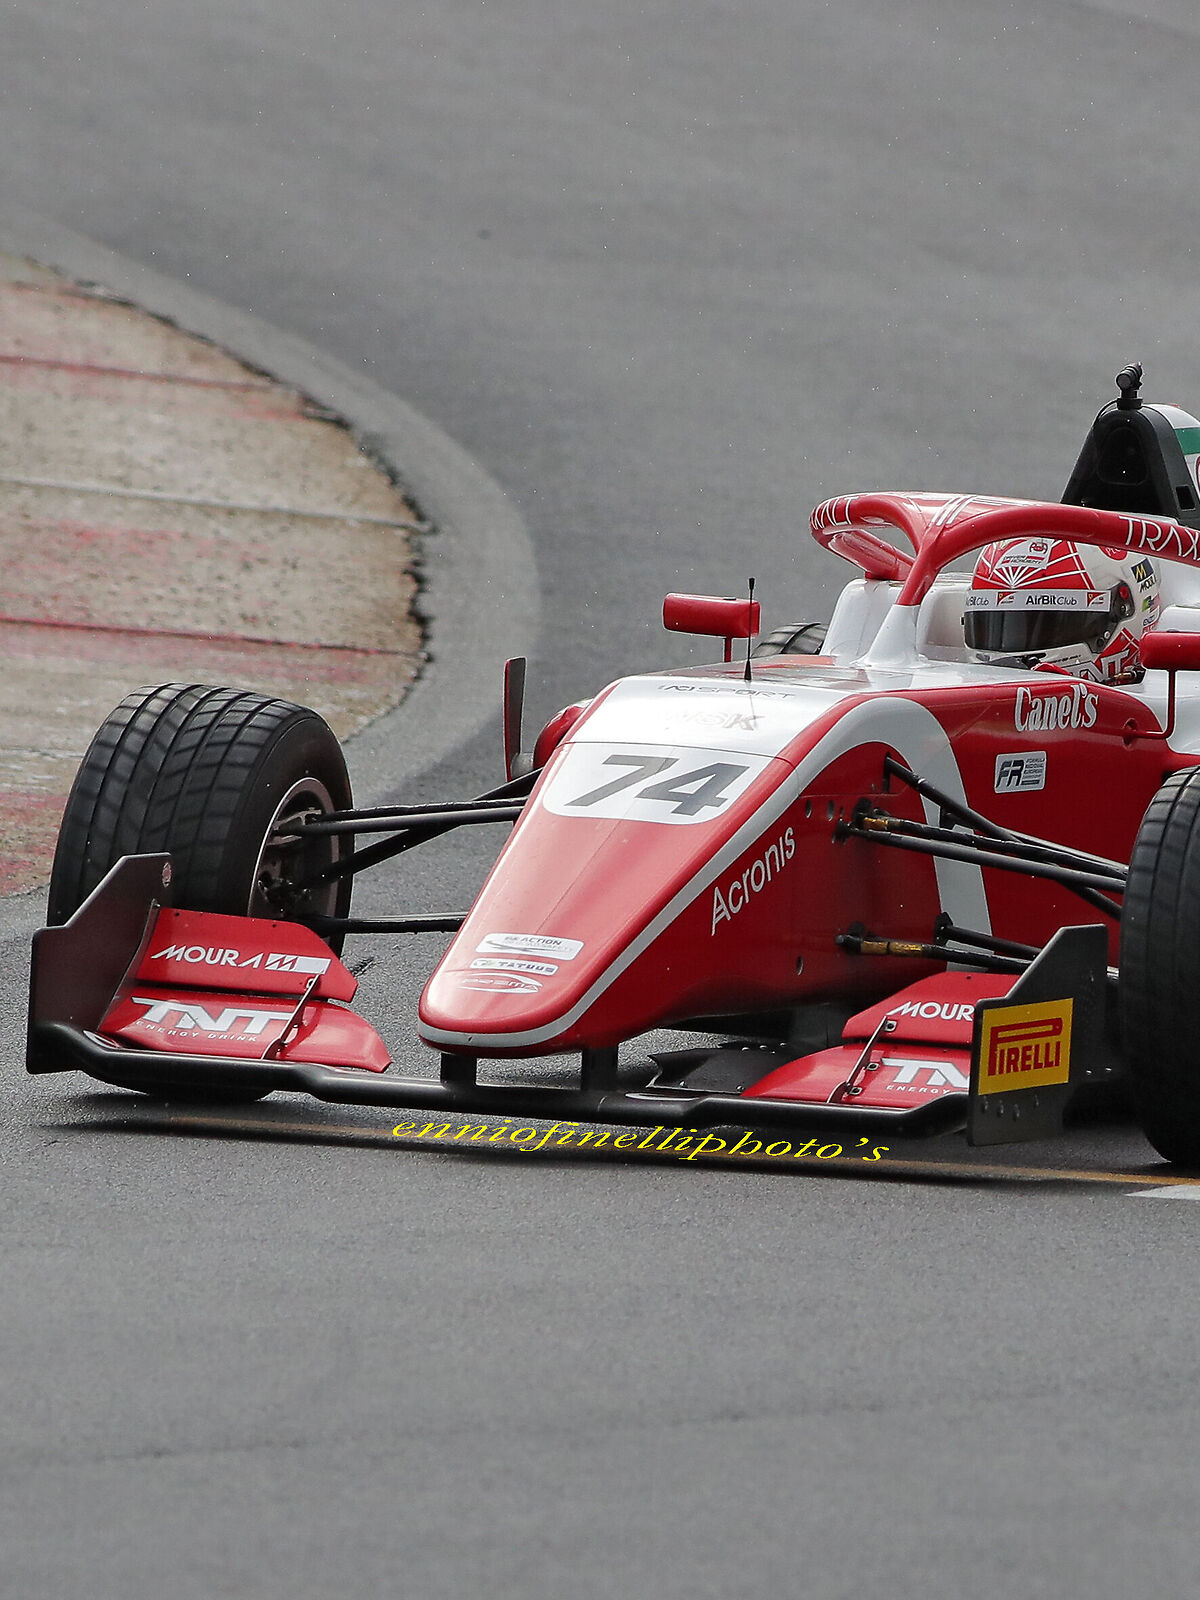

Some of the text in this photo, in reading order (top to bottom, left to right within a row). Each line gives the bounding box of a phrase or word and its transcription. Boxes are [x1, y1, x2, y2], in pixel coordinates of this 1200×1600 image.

[1025, 594, 1078, 606] AirBitClub
[1014, 683, 1099, 732] Canel's
[563, 753, 751, 817] 74
[711, 826, 797, 937] Acronis
[151, 944, 265, 969] MOURA
[497, 961, 555, 973] TATUUS
[131, 996, 295, 1034] TNT
[134, 1020, 258, 1042] ENERGY DRINK
[987, 1017, 1063, 1077] PIRELLI
